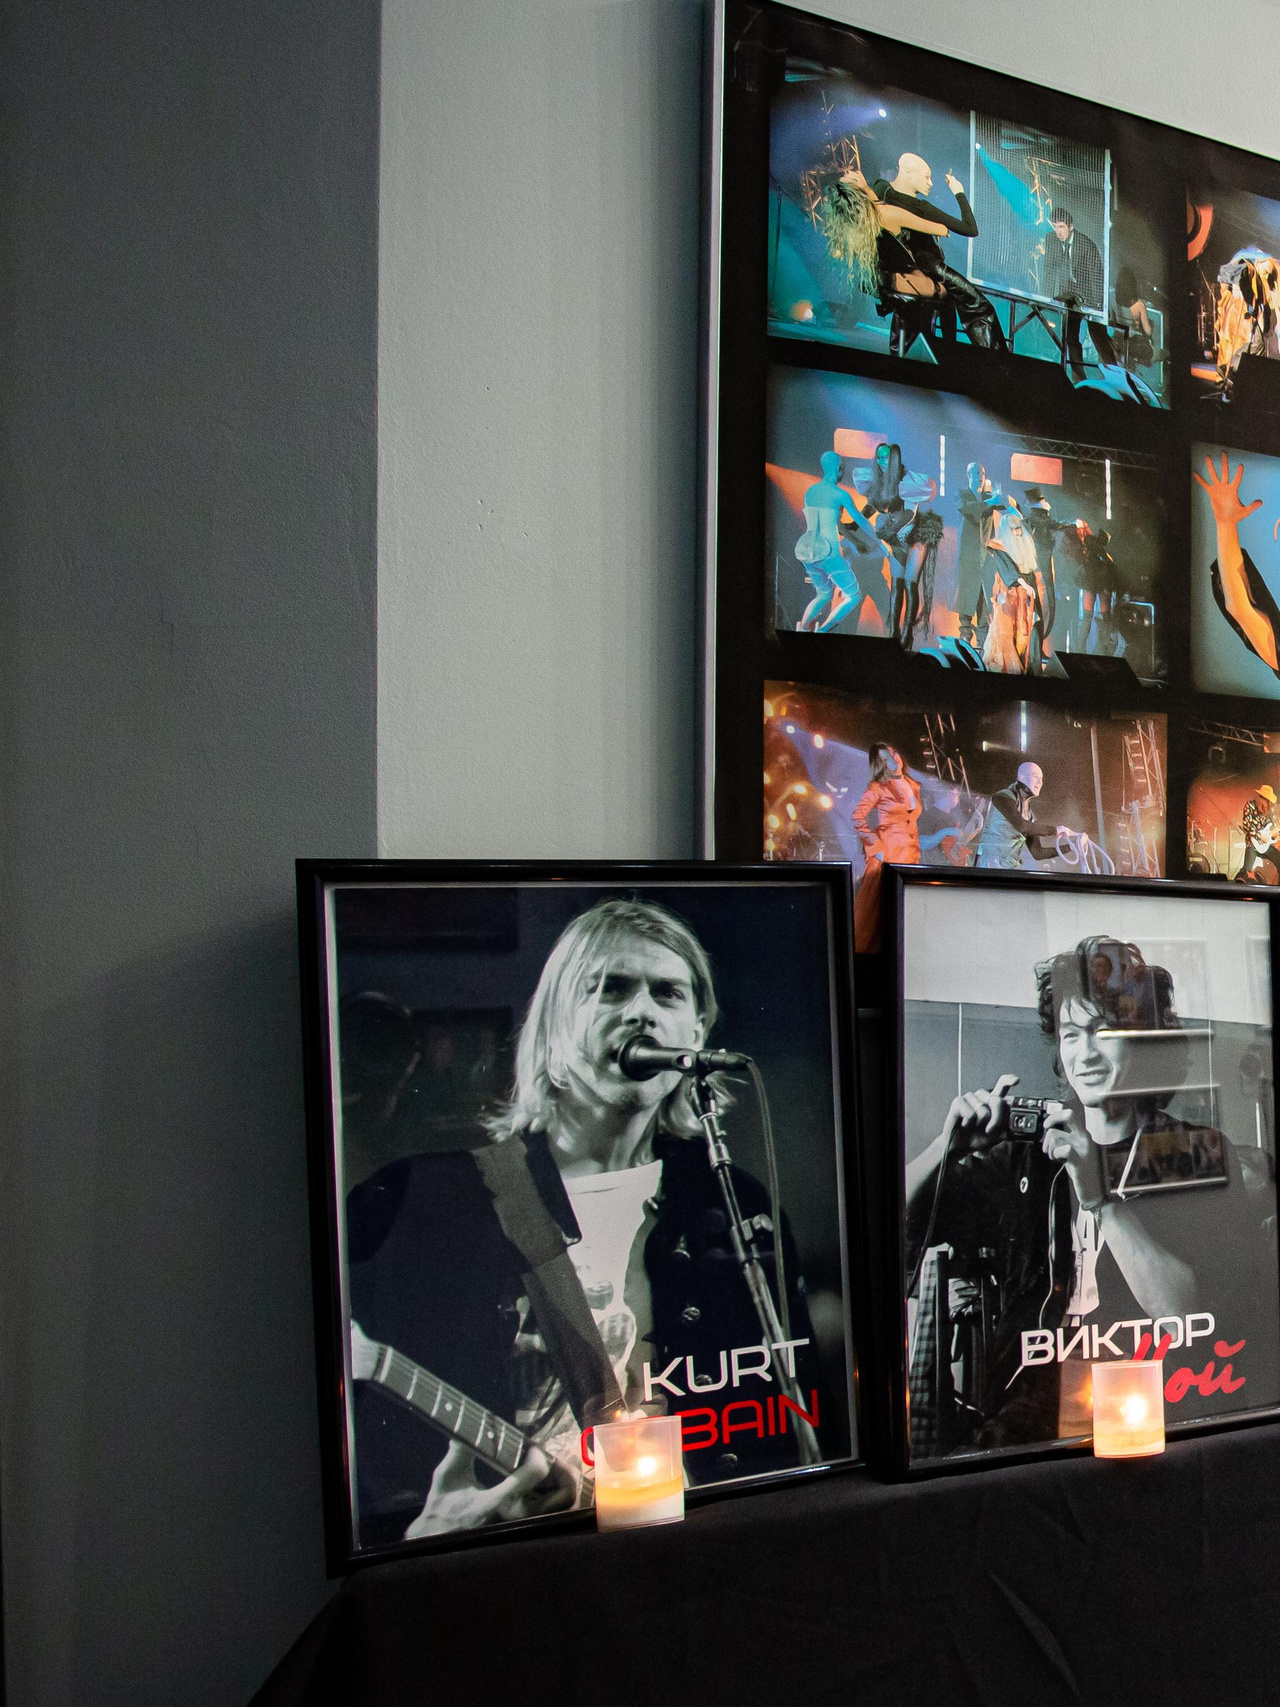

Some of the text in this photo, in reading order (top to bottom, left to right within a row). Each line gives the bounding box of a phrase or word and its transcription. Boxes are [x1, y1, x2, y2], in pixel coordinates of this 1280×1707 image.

[643, 1338, 810, 1402] KURT
[1021, 1312, 1216, 1367] ВИКТОР
[581, 1389, 820, 1467] BAIN
